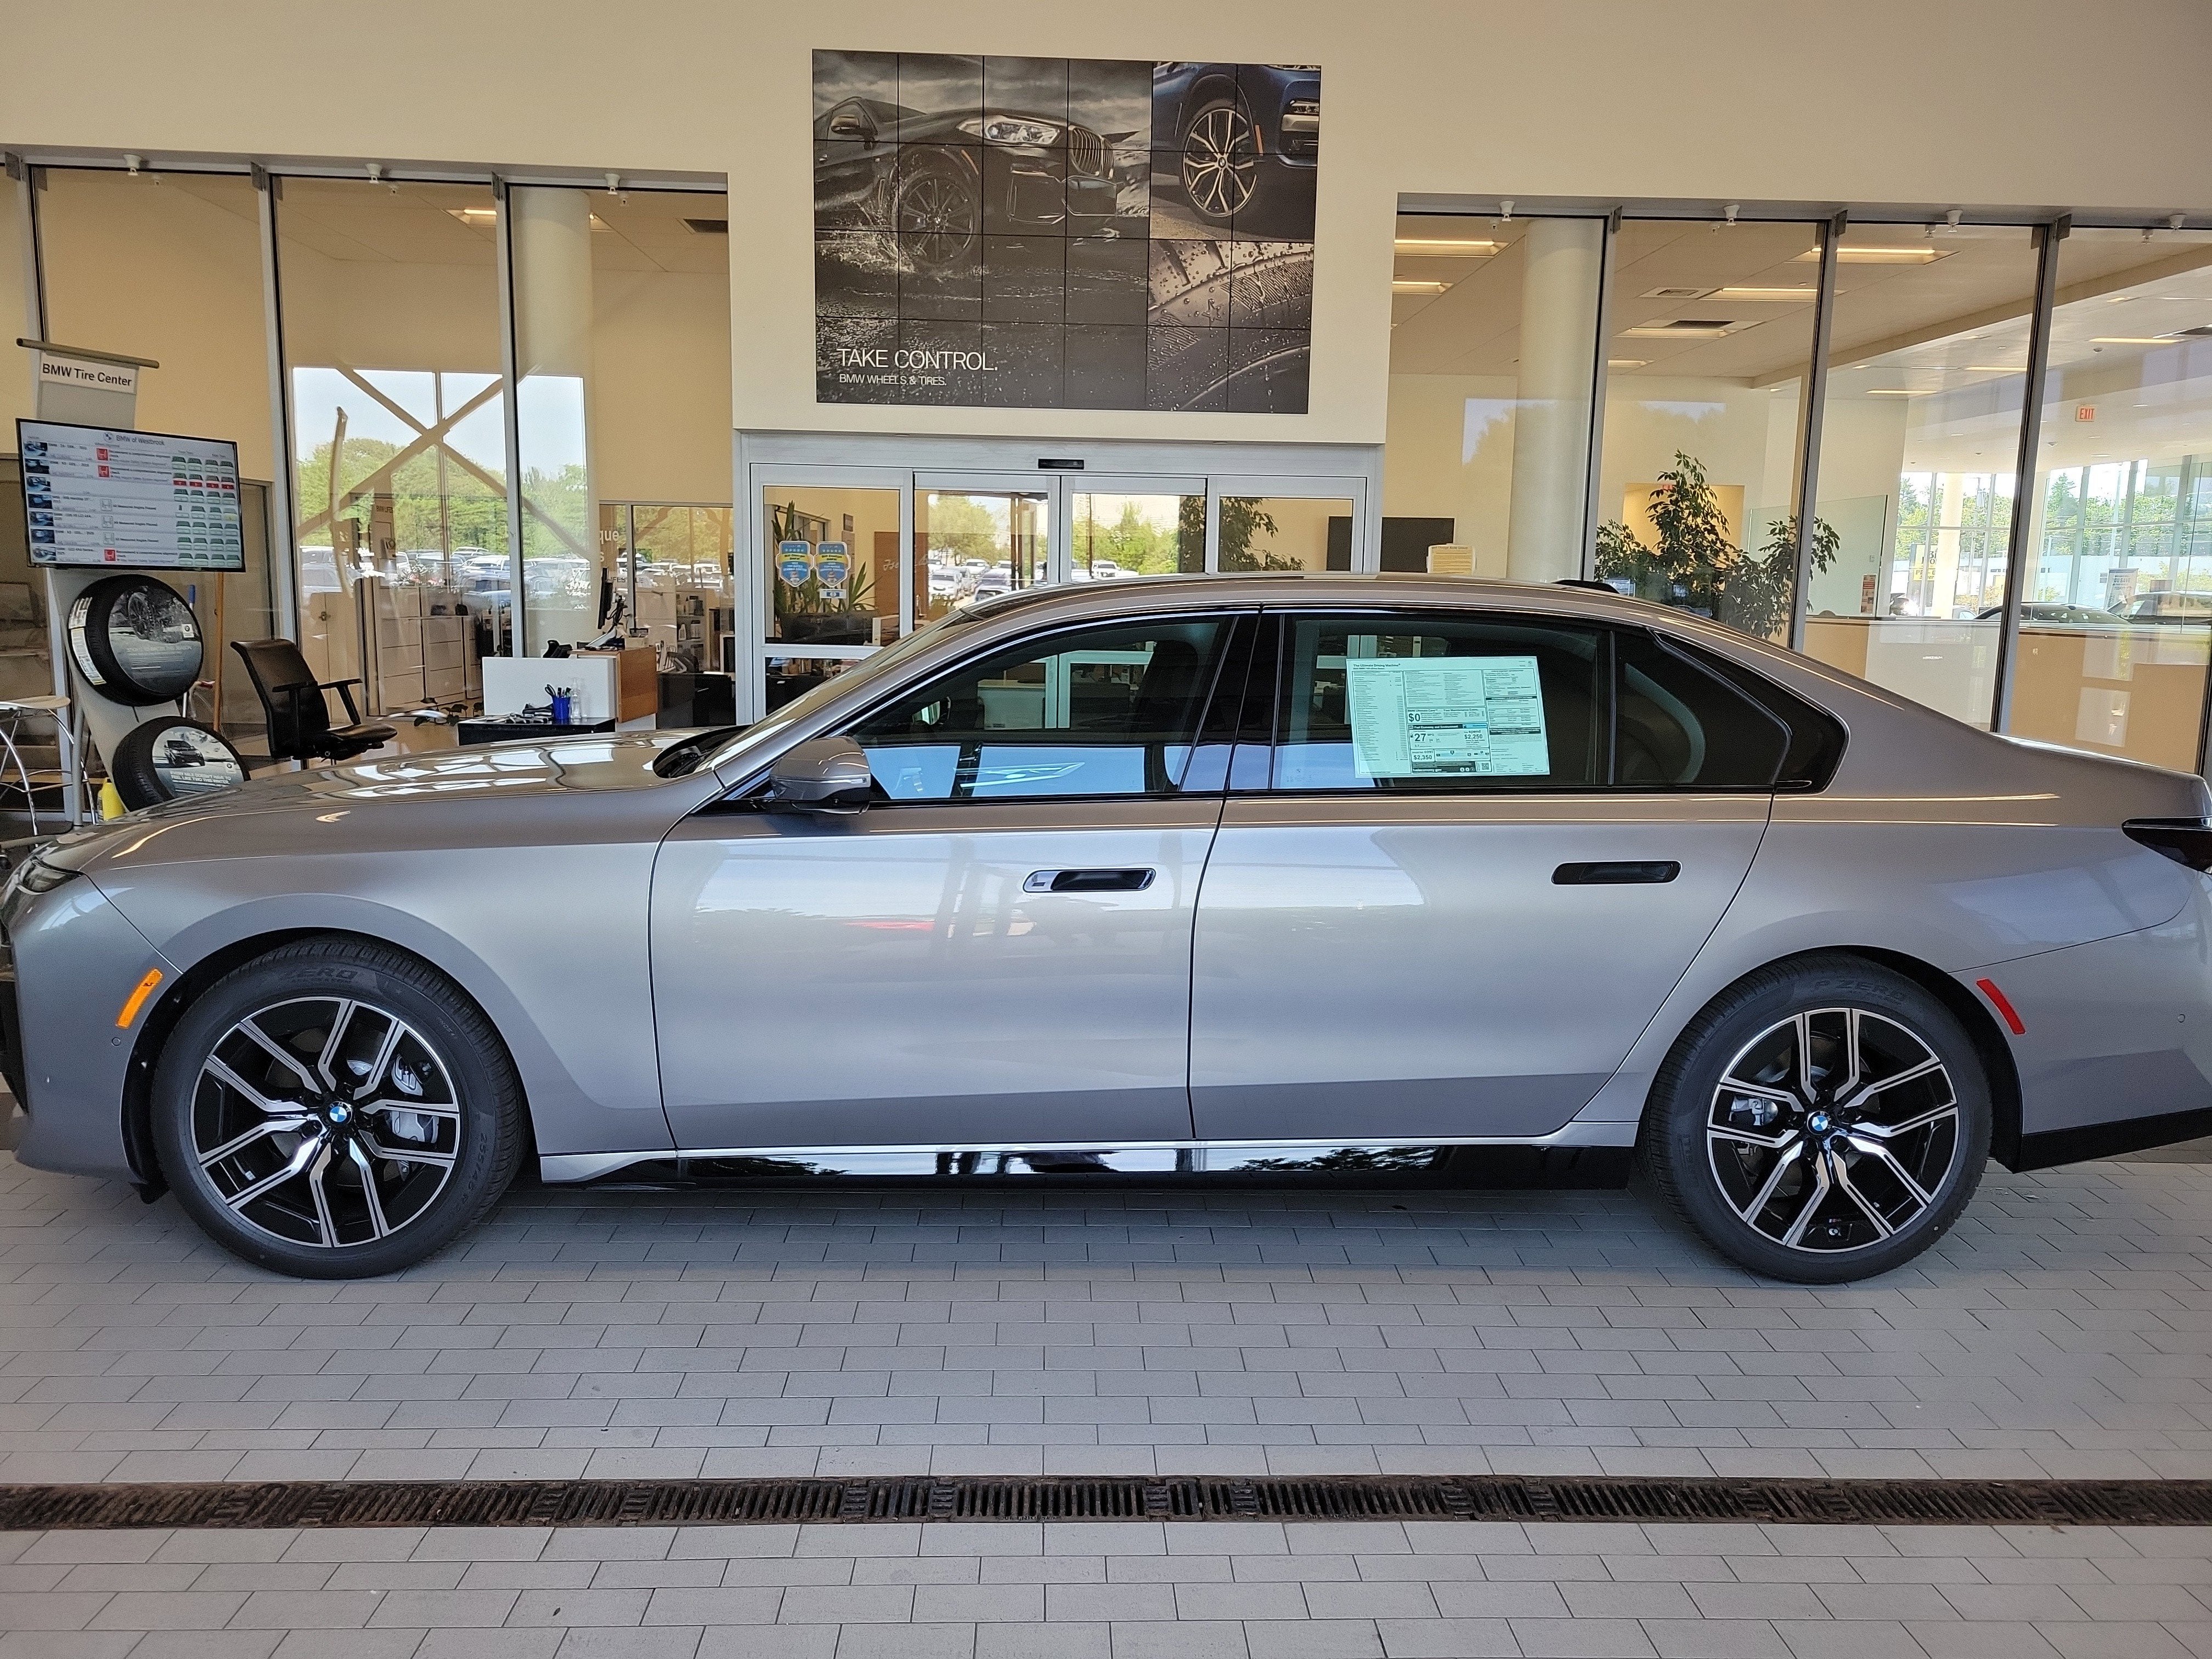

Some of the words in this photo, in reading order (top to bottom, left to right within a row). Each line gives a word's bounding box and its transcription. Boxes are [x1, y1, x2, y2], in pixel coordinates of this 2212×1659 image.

[836, 348, 889, 368] TAKE
[894, 349, 998, 371] CONTROL.
[42, 363, 72, 377] BMW
[74, 368, 95, 381] Tire
[98, 371, 132, 386] Center
[839, 374, 866, 384] BMW
[867, 375, 907, 385] WHEELS
[909, 376, 917, 386] &
[919, 376, 947, 386] TIRES.
[2079, 408, 2095, 420] EXIT
[138, 437, 165, 445] Westbrook
[1408, 713, 1420, 722] $0
[1414, 733, 1426, 742] 27
[329, 1102, 351, 1113] BMW
